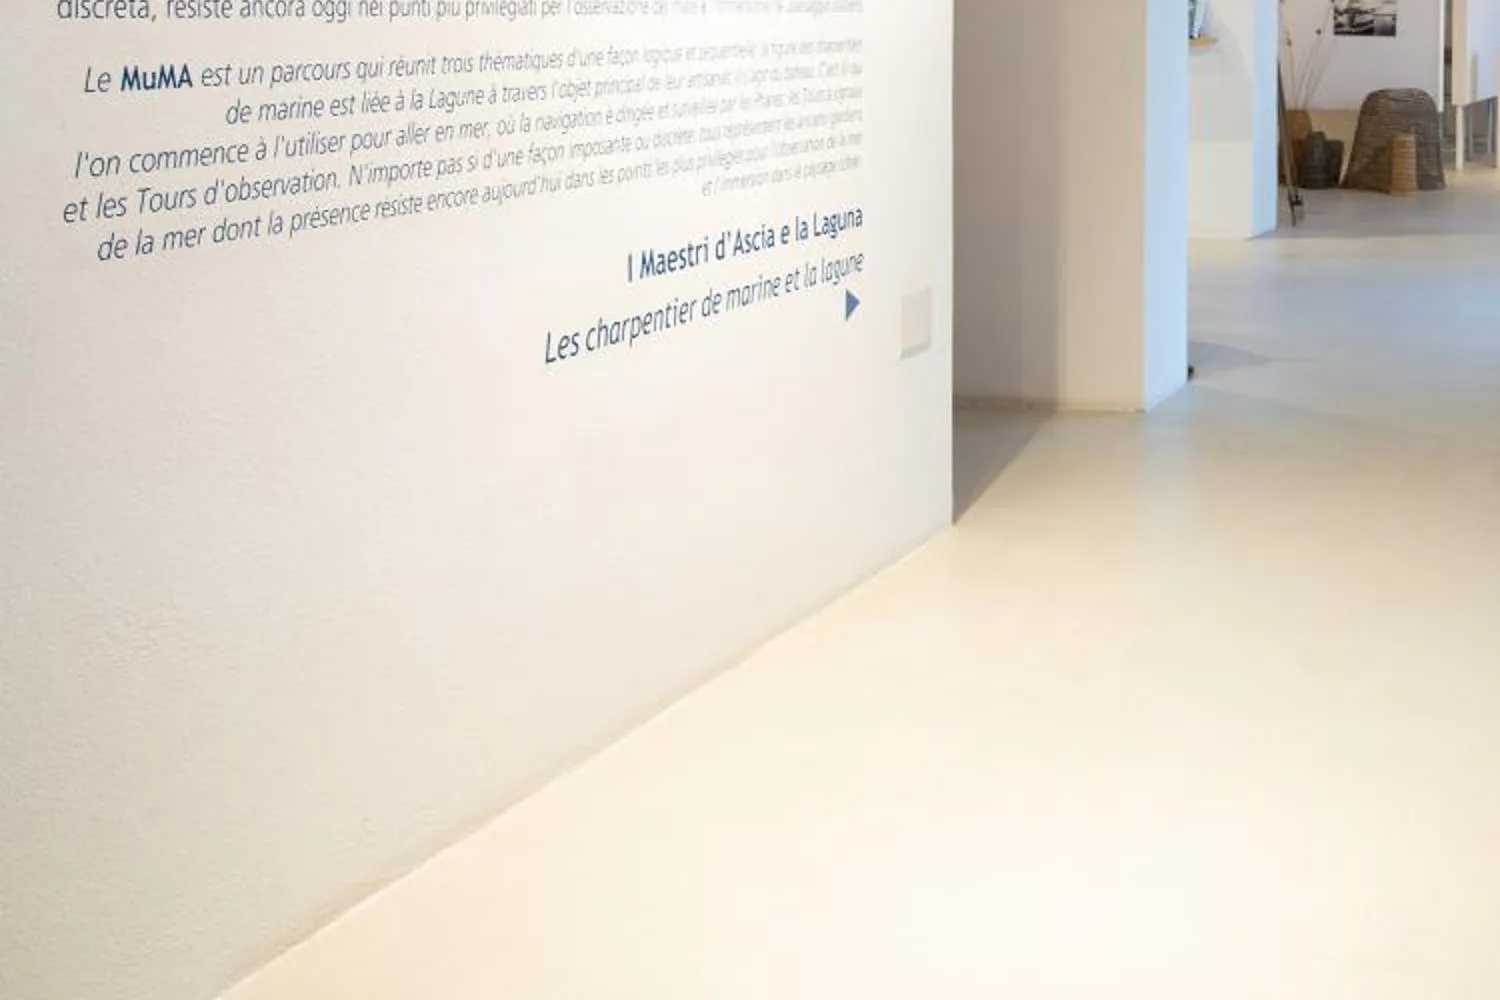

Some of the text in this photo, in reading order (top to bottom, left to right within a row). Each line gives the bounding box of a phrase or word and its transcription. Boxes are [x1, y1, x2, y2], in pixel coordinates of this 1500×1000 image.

[83, 65, 111, 93] Le
[120, 63, 194, 91] MuMA
[201, 63, 232, 87] est
[238, 64, 264, 86] un
[270, 59, 351, 89] parcours
[356, 55, 385, 82] qui
[388, 53, 436, 77] réunit
[441, 54, 474, 75] trois
[226, 97, 252, 124] de
[258, 95, 324, 120] marine
[330, 94, 355, 117] est
[361, 88, 390, 113] liée
[395, 88, 405, 111] à
[410, 88, 424, 110] la
[429, 88, 484, 113] Lagune
[502, 83, 547, 104] travers
[75, 151, 121, 178] l'on
[129, 143, 249, 173] commence
[255, 135, 267, 161] à
[274, 131, 346, 159] l'utiliser
[350, 130, 392, 158] pour
[395, 122, 430, 147] aller
[435, 124, 454, 143] en
[496, 117, 515, 137] où
[520, 112, 531, 133] la
[536, 110, 603, 134] navigation
[63, 196, 88, 224] et
[96, 192, 128, 219] les
[136, 187, 197, 214] Tours
[203, 168, 340, 205] d'observation.
[349, 159, 433, 189] N'importe
[436, 156, 463, 180] pas
[484, 147, 524, 170] d'une
[97, 232, 128, 261] de
[135, 227, 154, 256] la
[162, 224, 206, 250] mer
[212, 216, 262, 243] dont
[267, 209, 283, 236] la
[289, 202, 370, 238] présence
[427, 187, 478, 211] encore
[565, 169, 595, 190] dans
[627, 206, 863, 283] I Maestri d'Ascia e la Laguna
[545, 252, 865, 364] Les charpentier de marine et la lagune
